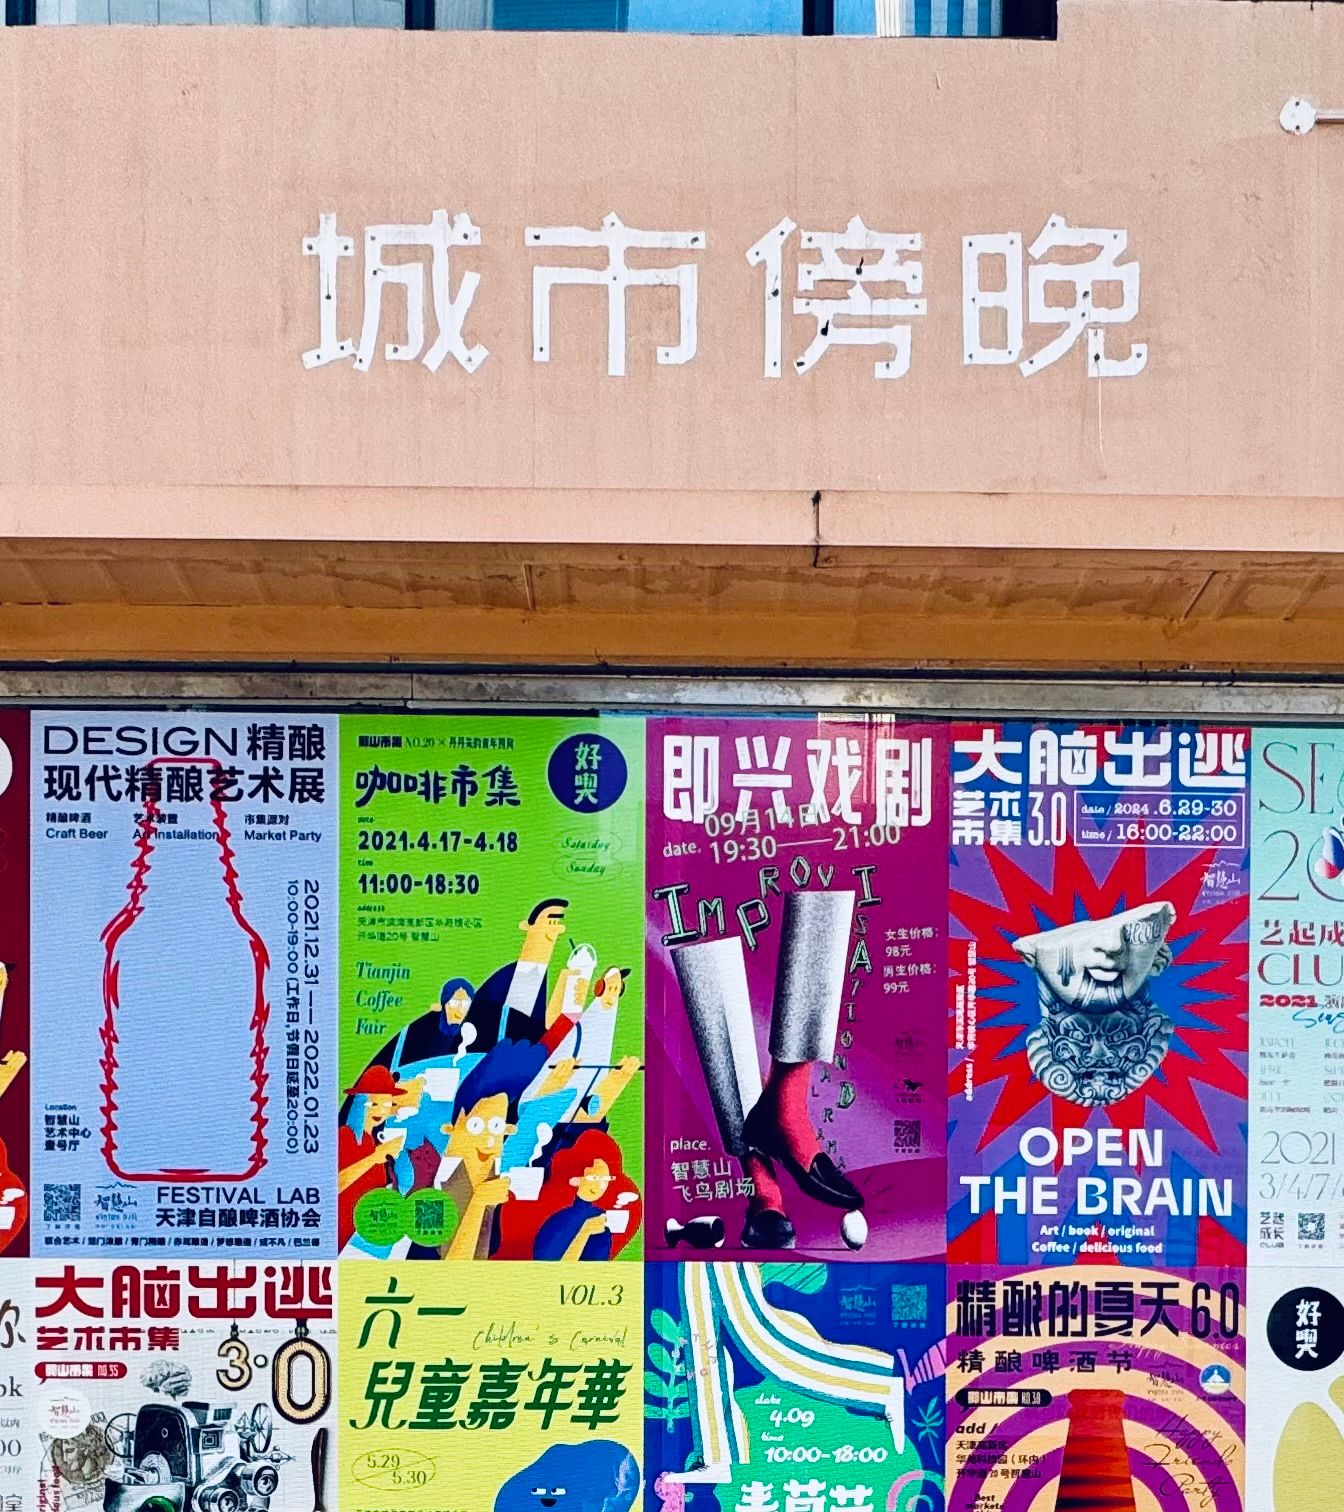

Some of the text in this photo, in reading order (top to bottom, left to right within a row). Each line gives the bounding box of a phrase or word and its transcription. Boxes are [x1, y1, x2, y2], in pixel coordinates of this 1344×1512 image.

[301, 209, 1149, 379] 城市傍晚
[44, 724, 326, 760] DESIGN 精酿
[954, 729, 1245, 788] 大脑出逃
[44, 765, 326, 803] 现代精酿艺术展
[356, 765, 521, 807] 咖啡市集
[663, 735, 932, 827] 即兴戏剧
[46, 829, 108, 839] Craft Beer
[359, 831, 518, 852] 2021.4.17-4.18
[1116, 824, 1237, 841] 16:00-22:00
[359, 873, 480, 894] 11:00-18:30
[45, 1127, 91, 1139] 艺术中心
[671, 1139, 711, 1152] place.
[1019, 1128, 1163, 1167] OPEN
[1260, 1131, 1336, 1165] 2021
[157, 1187, 320, 1204] FESTIVAL LAB
[960, 1176, 1231, 1216] THE BRAIN
[156, 1209, 321, 1229] 天津自酿啤酒协会
[35, 1266, 332, 1319] 大脑出逃
[560, 1284, 623, 1306] VOL.3
[357, 1277, 466, 1349] 六一
[956, 1281, 1180, 1337] 精酿的夏天
[37, 1327, 179, 1352] 艺术市集
[956, 1351, 1133, 1374] 精酿啤酒节
[350, 1358, 633, 1429] 兒童嘉年華
[770, 1408, 815, 1427] 4.09
[367, 1454, 400, 1469] 5.29
[765, 1446, 888, 1464] 10:00-18:00
[393, 1470, 427, 1485] 5.30
